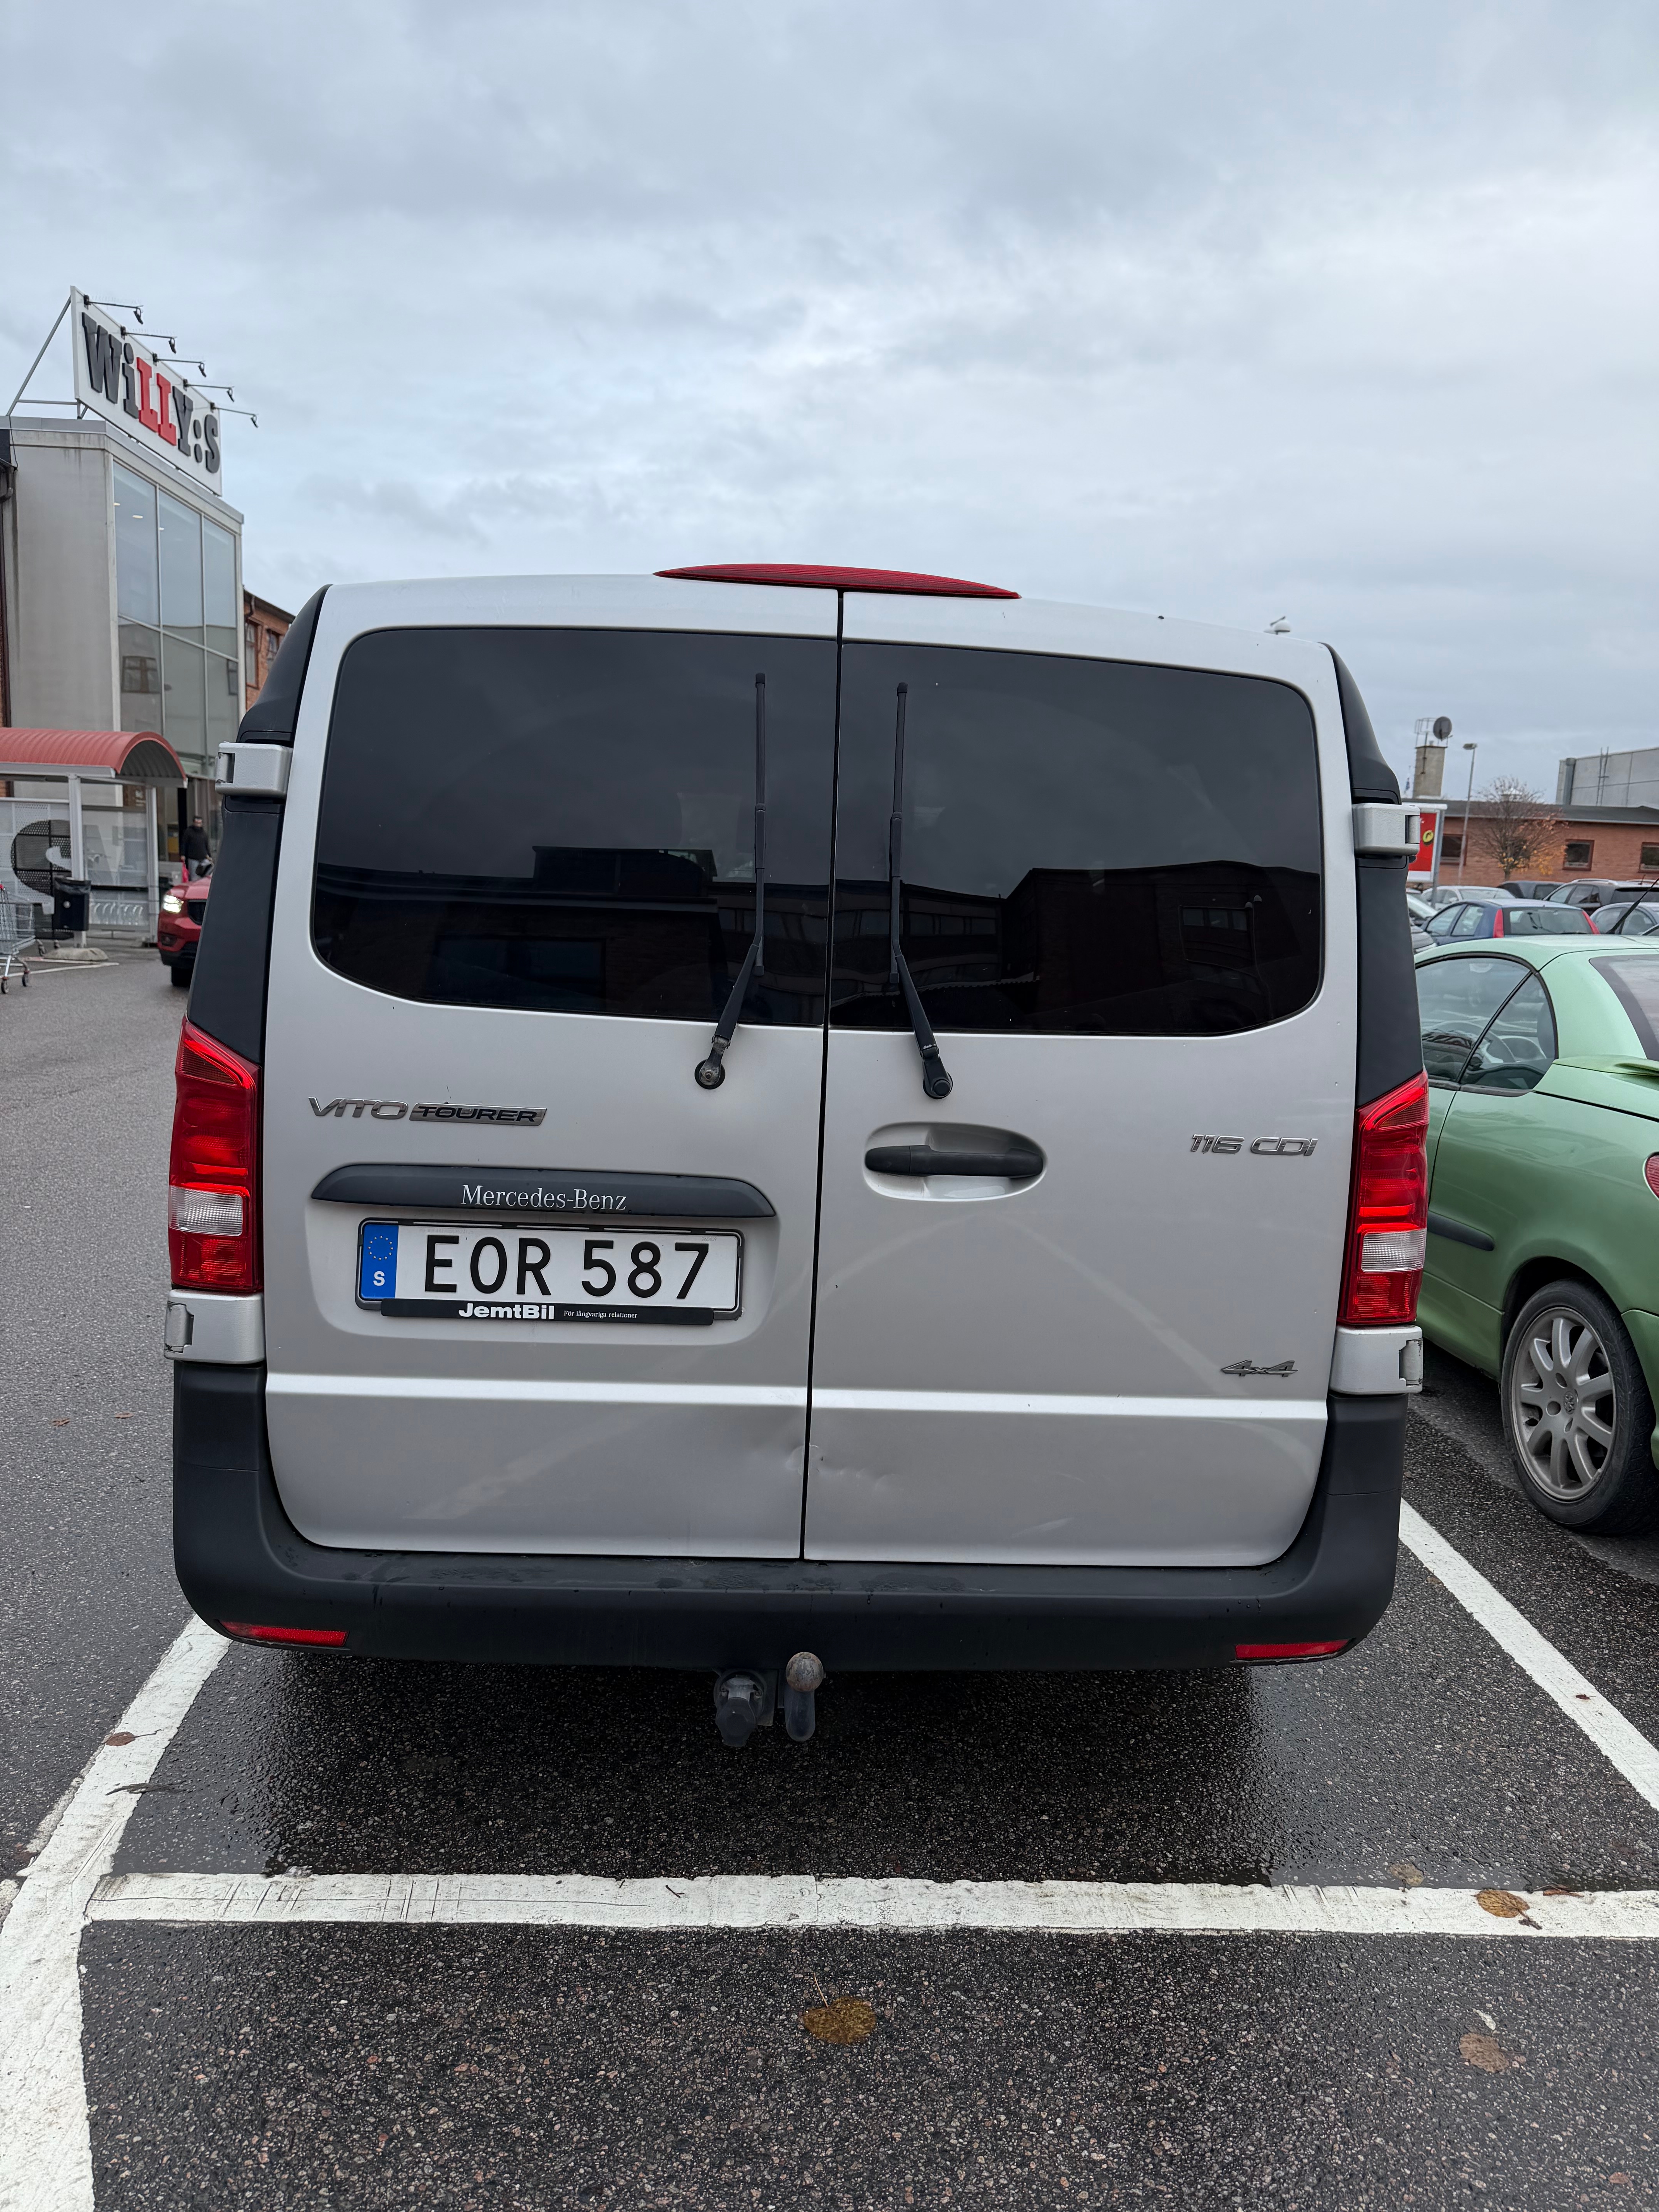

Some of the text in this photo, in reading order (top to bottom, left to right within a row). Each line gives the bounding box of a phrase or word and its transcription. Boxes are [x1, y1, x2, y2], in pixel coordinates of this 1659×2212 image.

[308, 1096, 538, 1122] VITO TOURER
[1190, 1134, 1245, 1154] 116
[461, 1184, 627, 1210] Mercedes-Benz
[424, 1235, 709, 1299] EOR 587
[373, 1271, 385, 1286] S
[459, 1303, 555, 1319] JemtBil
[576, 1310, 607, 1319] långvariga
[1221, 1359, 1298, 1377] 4x4
